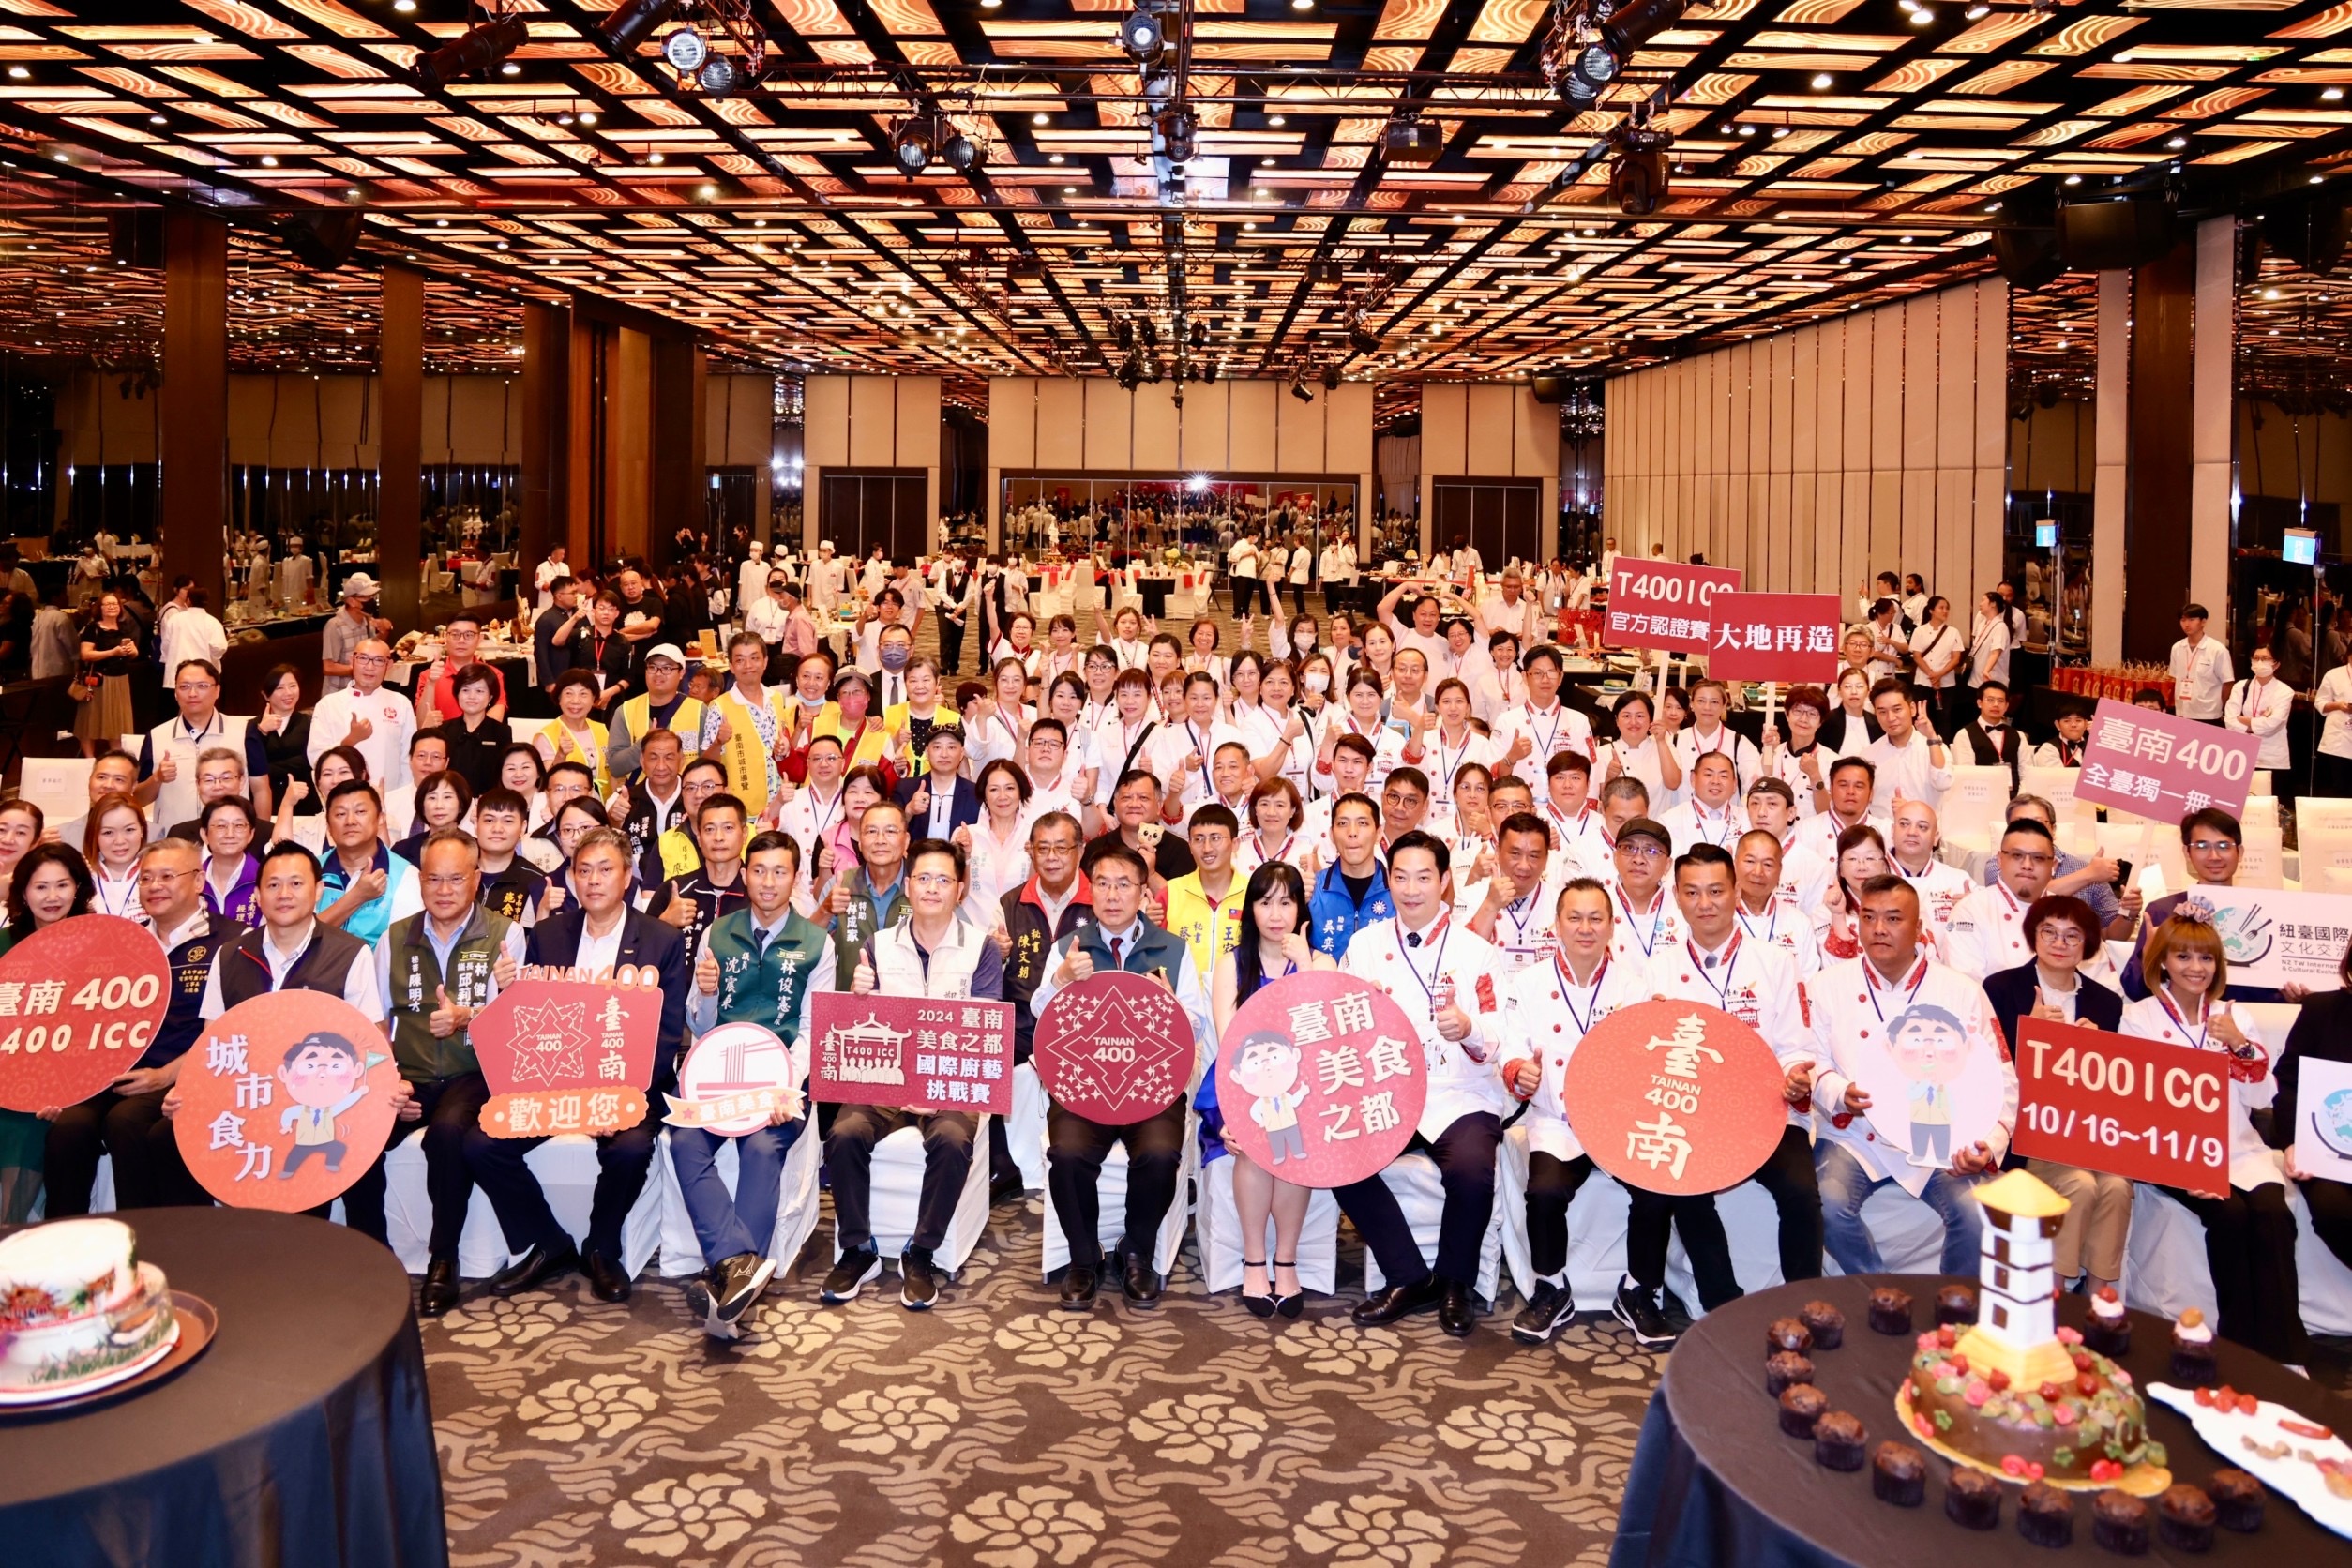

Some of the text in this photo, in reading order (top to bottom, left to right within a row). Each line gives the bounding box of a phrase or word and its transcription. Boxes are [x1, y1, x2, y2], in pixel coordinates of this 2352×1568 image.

[1610, 611, 1710, 642] 官方認證賽
[1712, 622, 1835, 654] 大地再造
[2095, 716, 2247, 782] 臺南 400
[245, 892, 257, 926] 臺南市
[595, 963, 660, 993] 400
[2288, 966, 2315, 974] Cultural
[0, 974, 160, 1016] 臺南 400
[595, 995, 630, 1031] 臺
[917, 1007, 1003, 1030] 2024 臺南
[1286, 989, 1375, 1047] 臺南
[87, 1020, 152, 1050] ICC
[535, 1040, 563, 1052] 400
[536, 1033, 563, 1041] TAINAN
[600, 1037, 625, 1048] 400
[916, 1029, 1003, 1055] 美食之都
[1093, 1036, 1135, 1046] TAINAN
[1644, 1011, 1725, 1079] 臺
[597, 1050, 626, 1081] 南
[845, 1046, 895, 1058] T400 ICC
[916, 1053, 1003, 1080] 國際廚藝
[1093, 1046, 1137, 1063] 400
[1315, 1034, 1412, 1096] 美食
[820, 1063, 838, 1082] 南
[1650, 1074, 1702, 1096] TAINAN
[699, 1089, 775, 1123] 臺南美食
[926, 1079, 991, 1105] 挑戰賽
[1643, 1087, 1699, 1115] 400
[205, 1033, 274, 1182] 城市食力
[507, 1092, 621, 1134] 歡迎您
[1319, 1090, 1401, 1144] 之都
[1626, 1110, 1693, 1181] 南
[2021, 1101, 2224, 1168] 10/16~11/9
